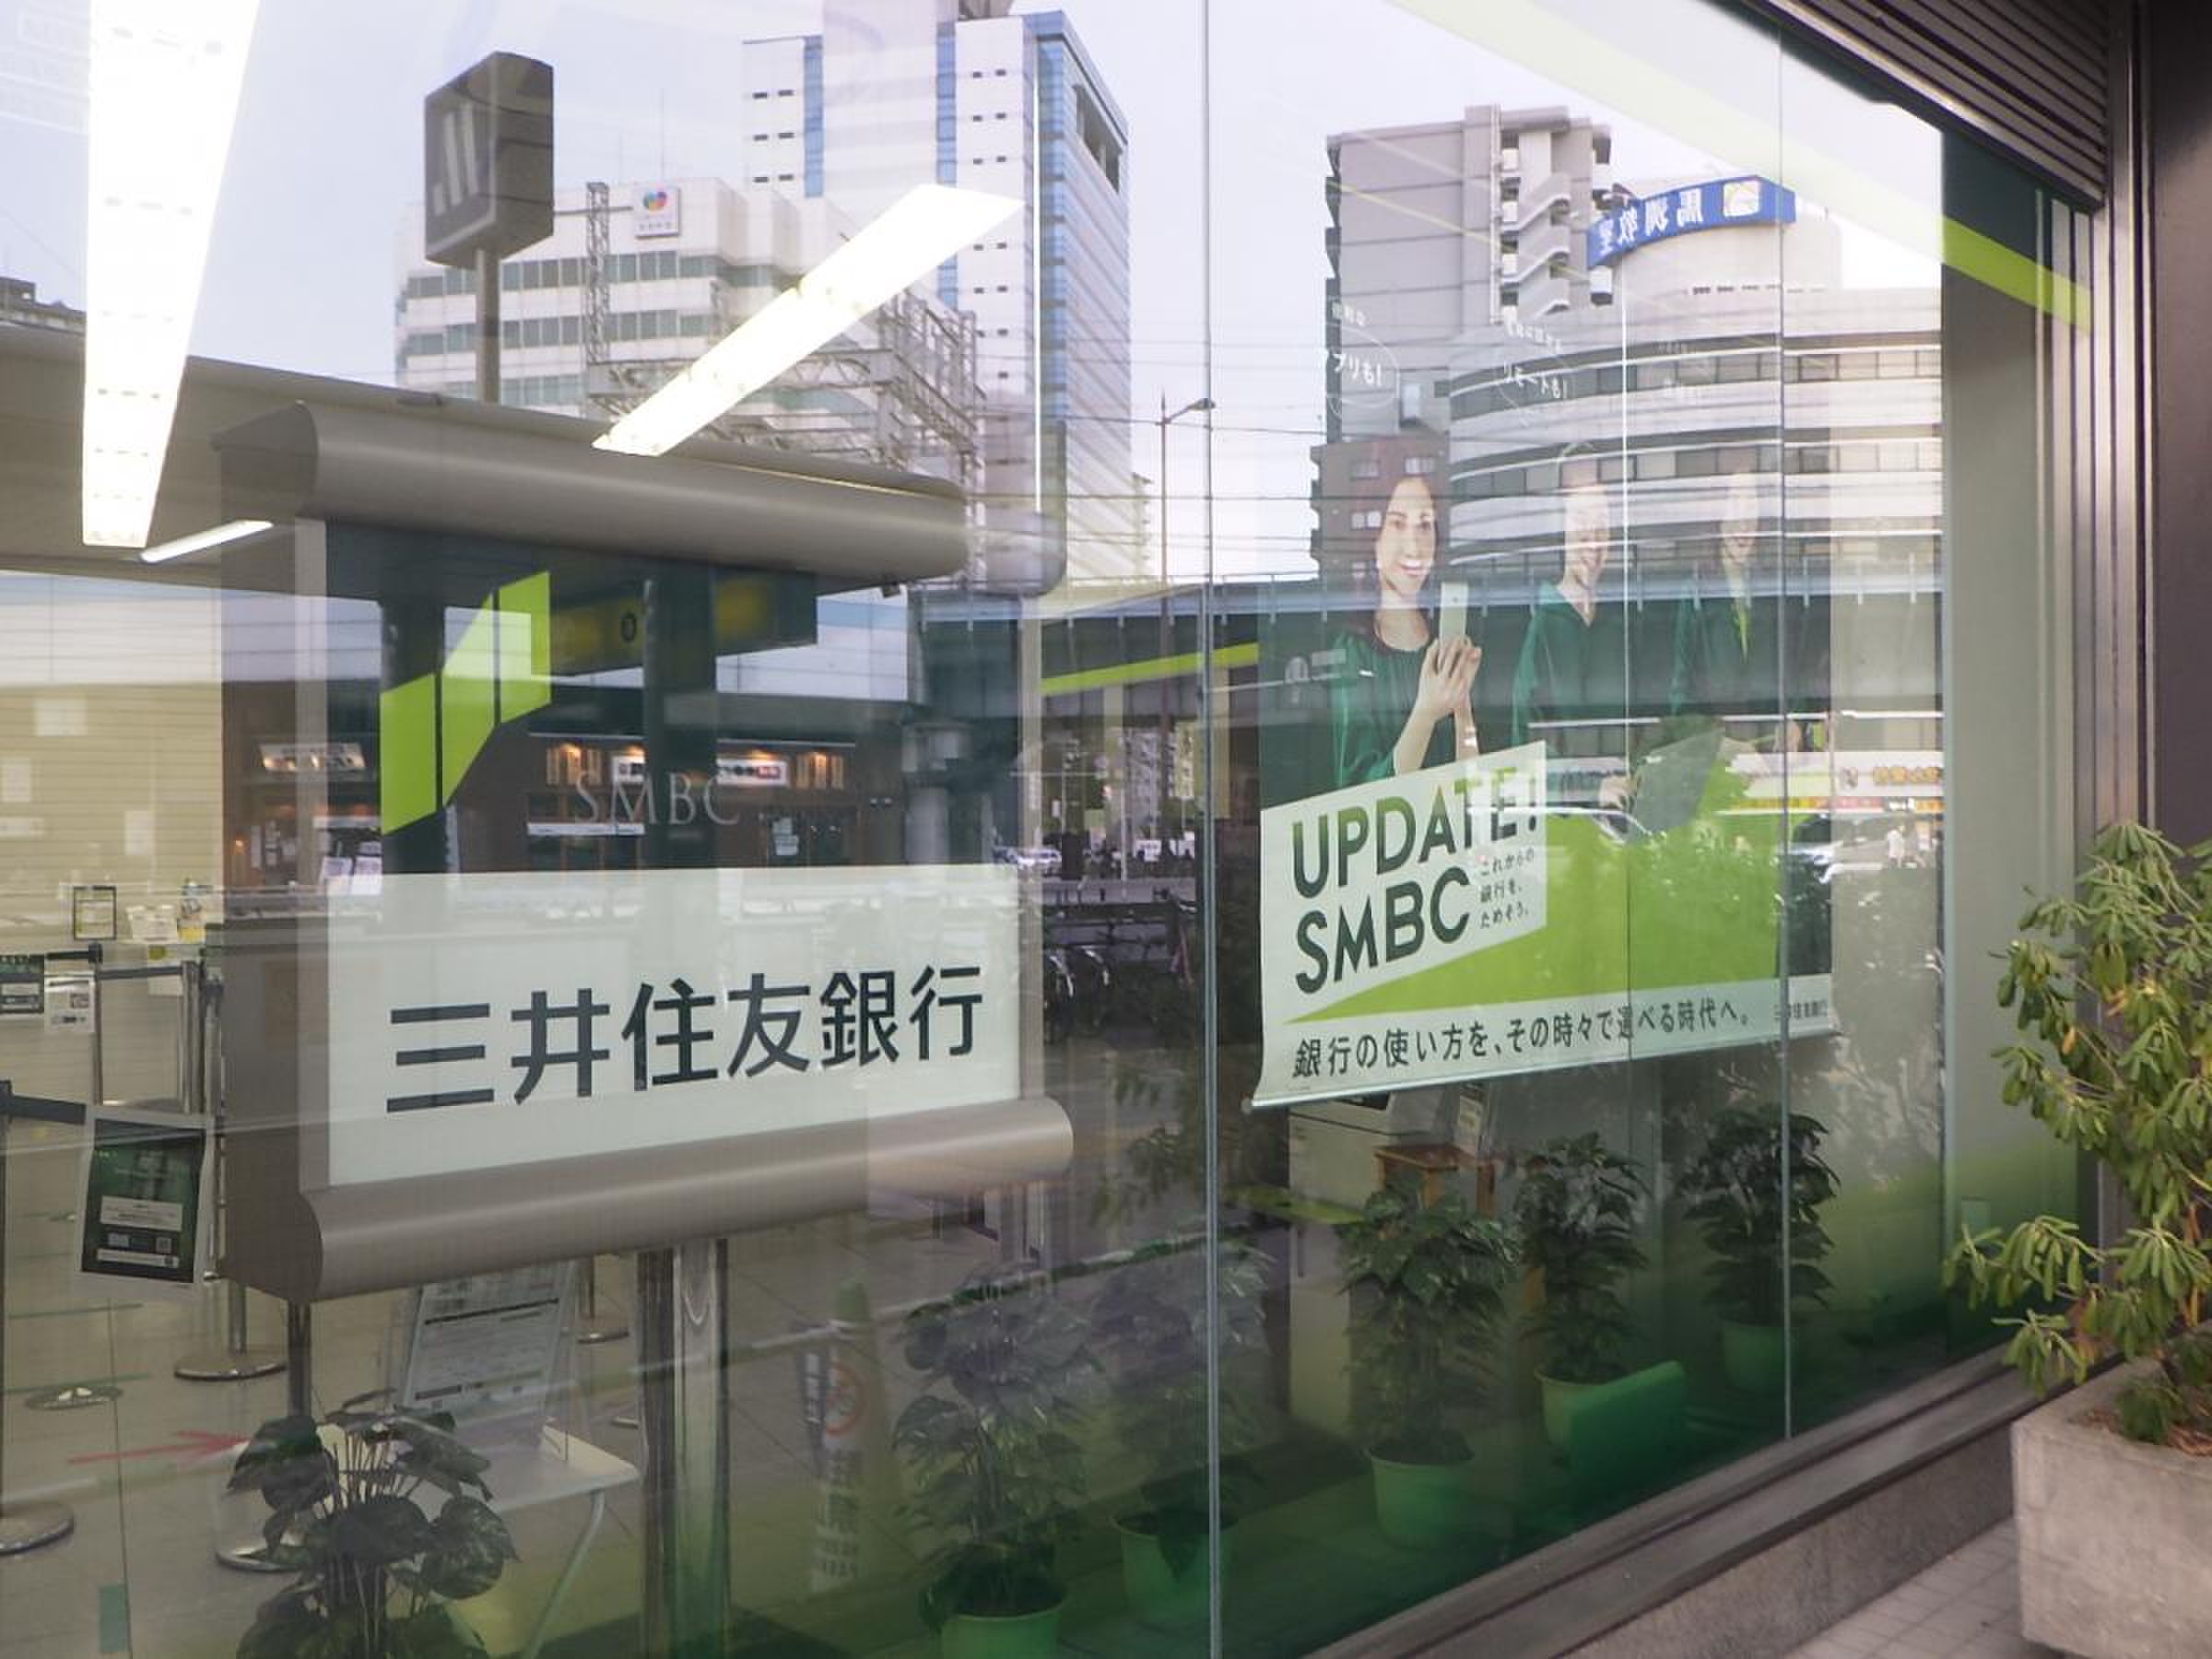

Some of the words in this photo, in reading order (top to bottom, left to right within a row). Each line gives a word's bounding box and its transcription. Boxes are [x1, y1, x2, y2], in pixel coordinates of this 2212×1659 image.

[574, 771, 740, 826] SMBC
[1292, 767, 1537, 899] UPDATE!
[1295, 865, 1471, 994] SMBC
[385, 964, 983, 1113] 三井住友銀行
